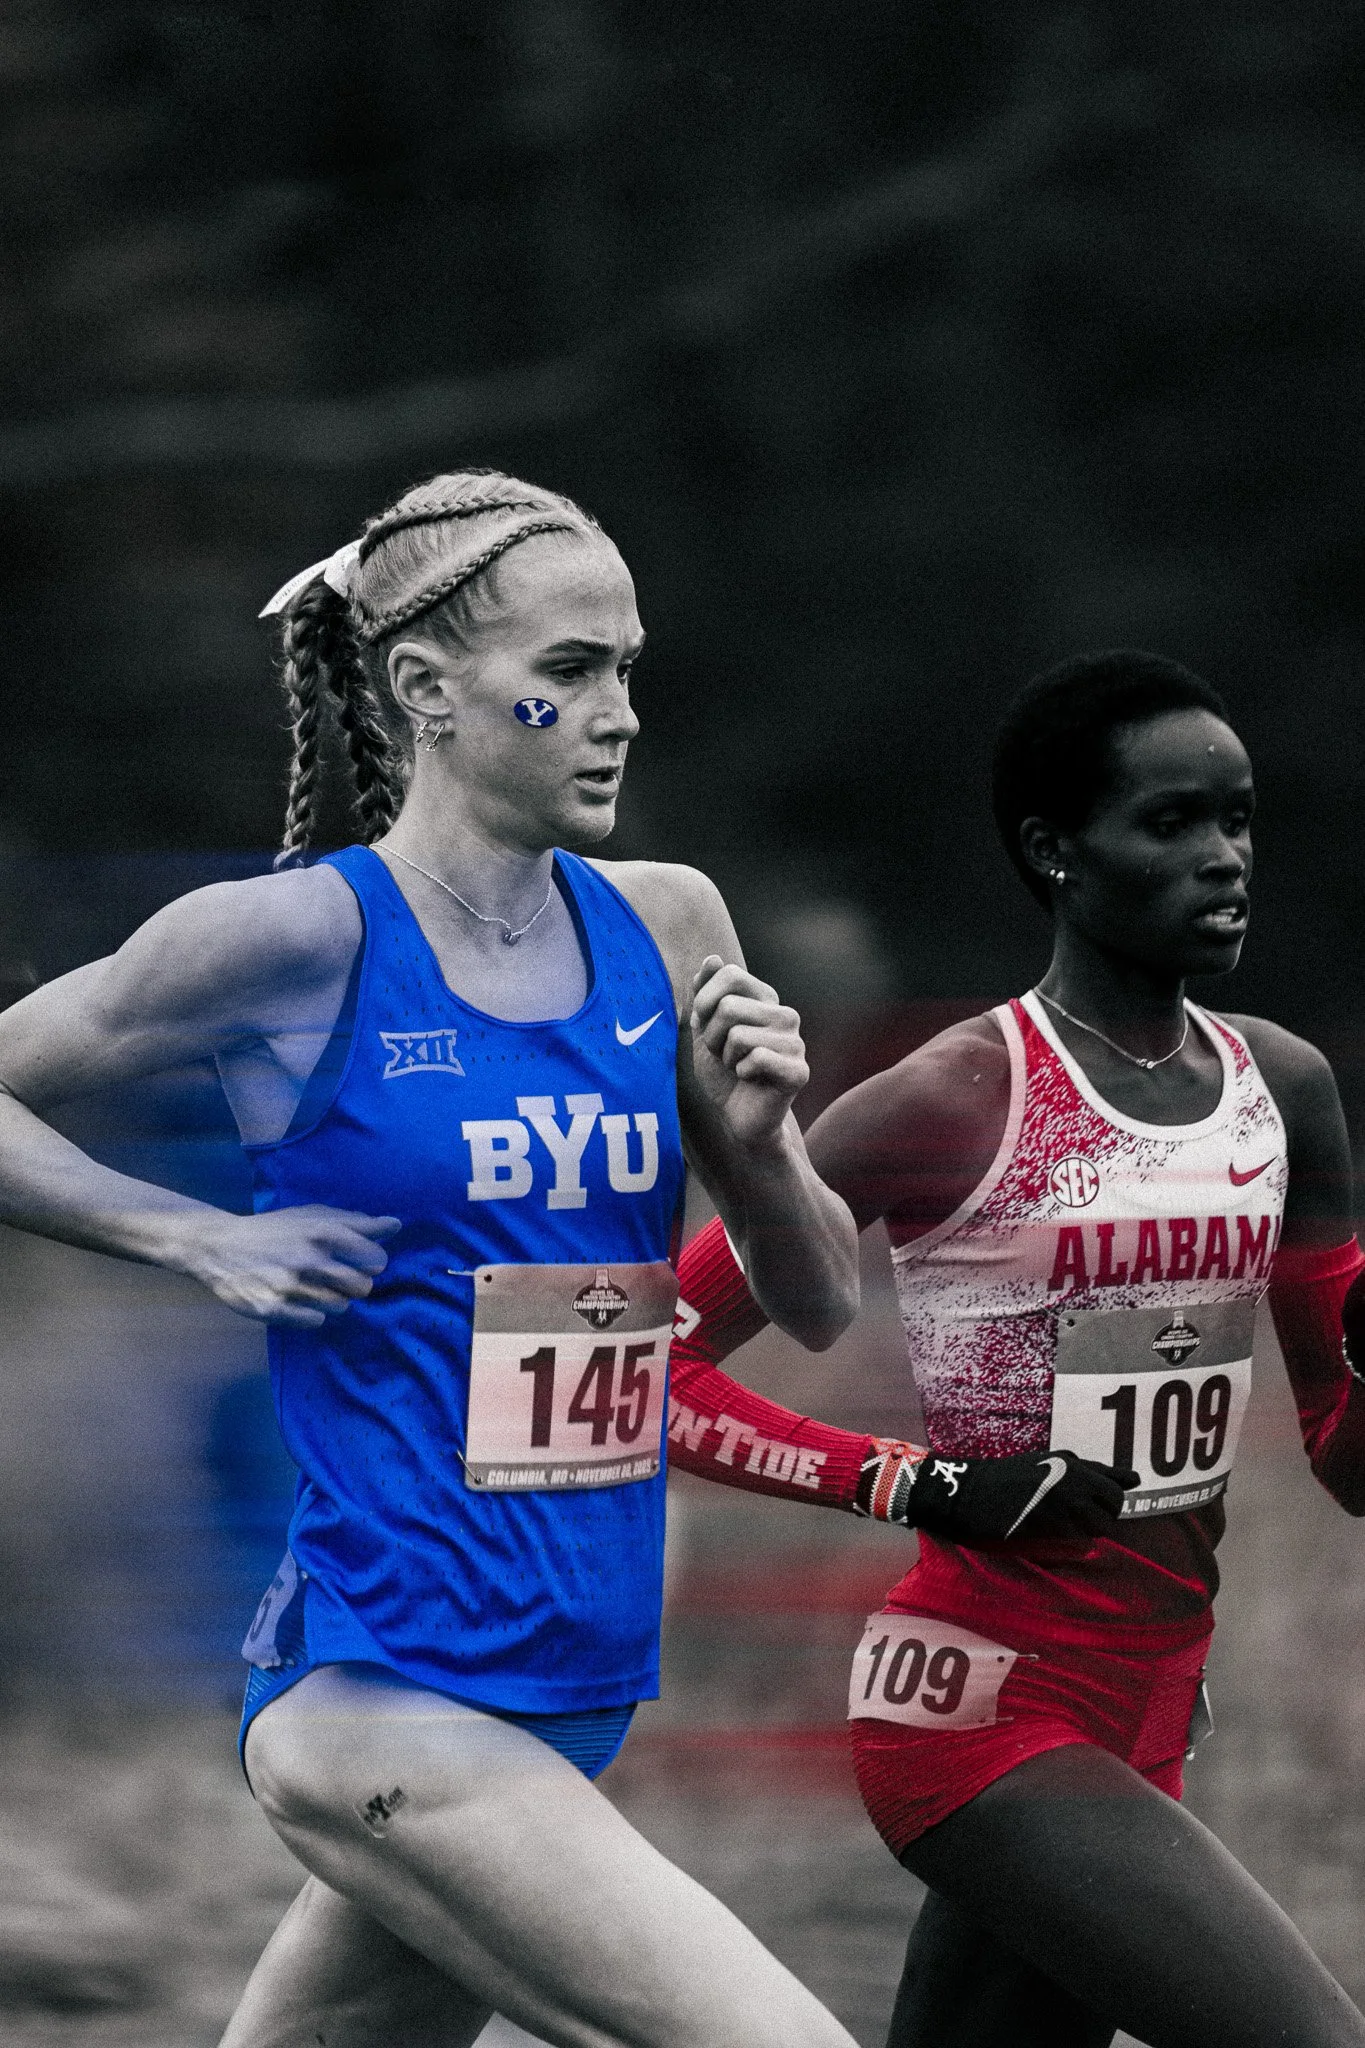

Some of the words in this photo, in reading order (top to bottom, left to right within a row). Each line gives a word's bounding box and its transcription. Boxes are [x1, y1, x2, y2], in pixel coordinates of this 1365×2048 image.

[521, 700, 553, 726] Y
[461, 1093, 660, 1210] BYU
[1051, 1158, 1099, 1206] SEC
[1046, 1214, 1279, 1291] ALABAM
[573, 1300, 629, 1310] CHAMPIONSHIPS
[520, 1341, 655, 1448] 145
[1101, 1374, 1231, 1477] 109
[864, 1635, 971, 1715] 109
